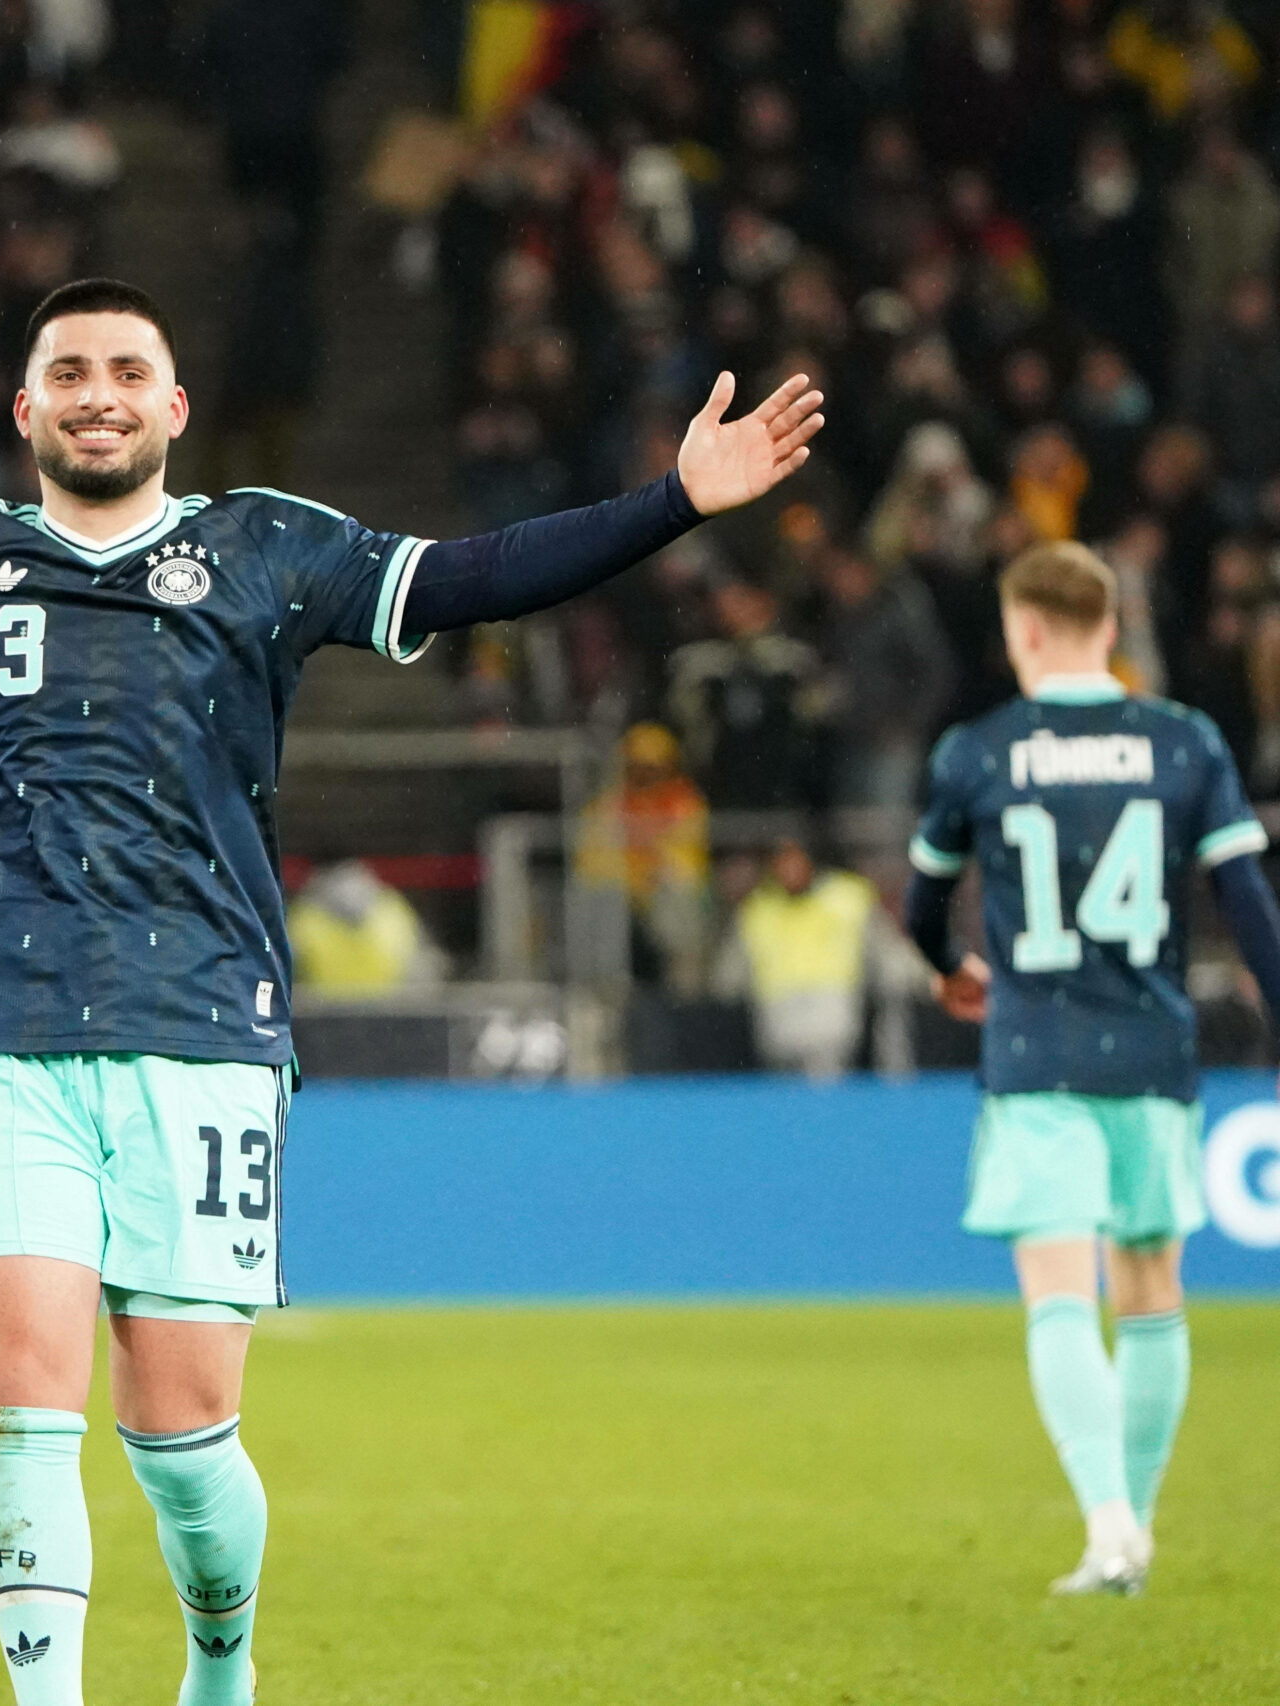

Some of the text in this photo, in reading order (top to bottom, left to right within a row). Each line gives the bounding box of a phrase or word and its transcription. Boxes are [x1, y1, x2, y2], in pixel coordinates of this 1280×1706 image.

[1009, 728, 1154, 790] FÜHRICH
[1002, 799, 1170, 973] 14
[196, 1125, 273, 1221] 13
[187, 1584, 242, 1601] DFB
